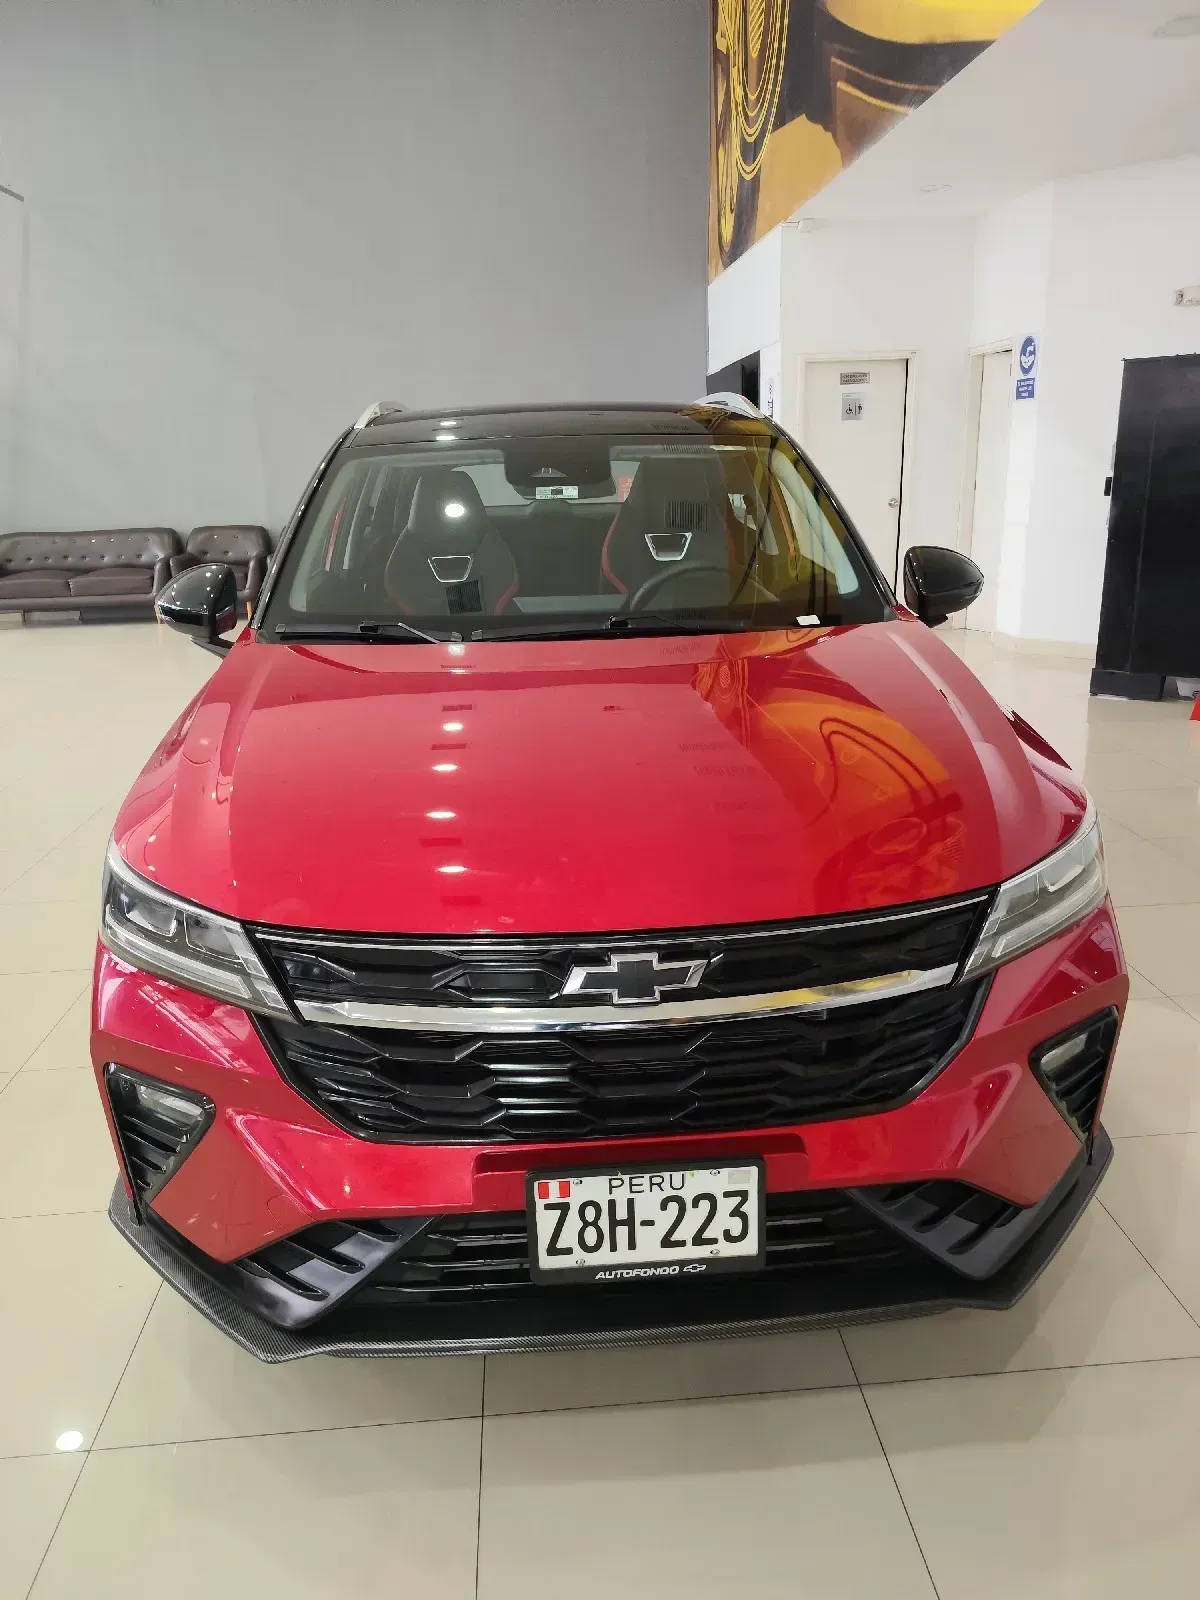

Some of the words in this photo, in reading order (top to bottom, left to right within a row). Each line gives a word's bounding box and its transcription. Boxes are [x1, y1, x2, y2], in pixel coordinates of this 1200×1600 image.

[608, 1173, 685, 1195] PERU
[543, 1189, 749, 1257] Z8H-223
[595, 1265, 680, 1280] AUTOFONDO
